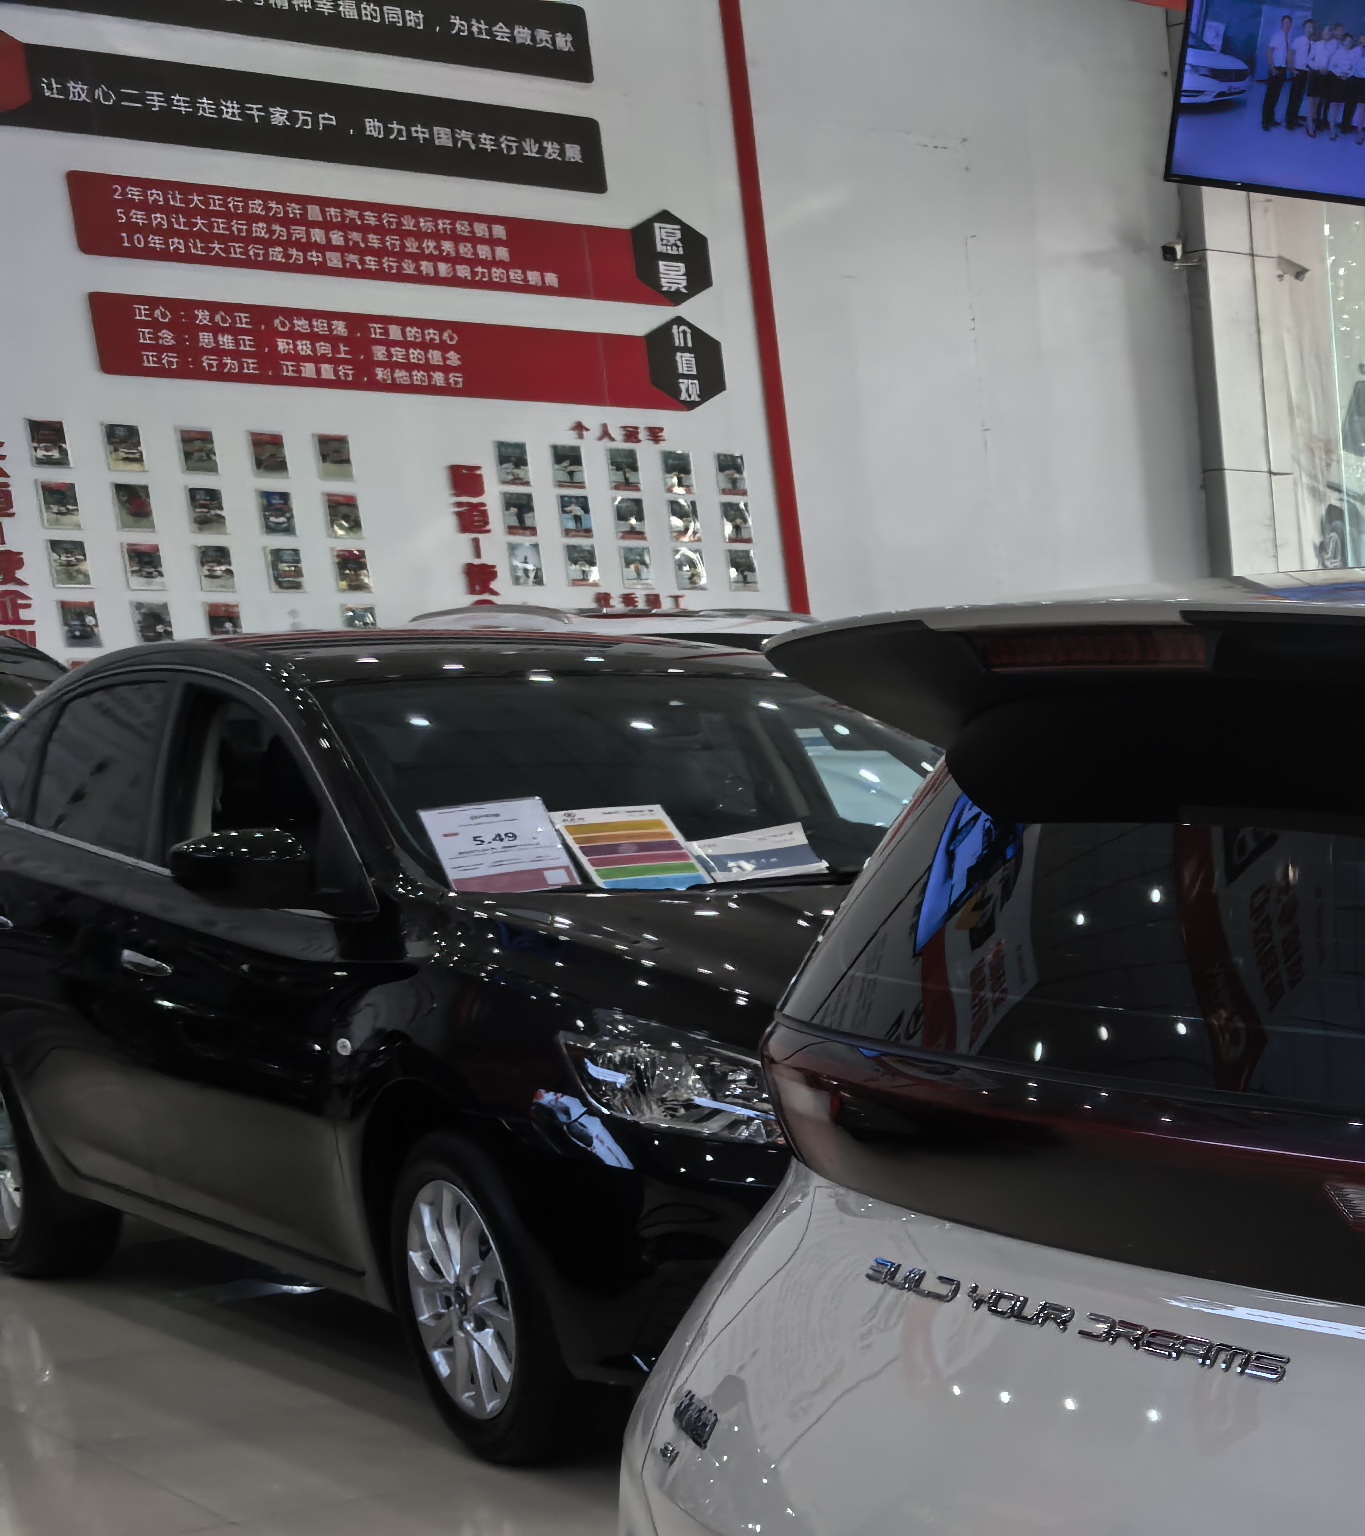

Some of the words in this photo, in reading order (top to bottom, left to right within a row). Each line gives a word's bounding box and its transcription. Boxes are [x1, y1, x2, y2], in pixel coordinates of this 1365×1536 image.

[653, 222, 688, 293] 愿景
[672, 324, 701, 402] 价值观
[472, 831, 518, 846] 5.49
[967, 1281, 1075, 1333] YOUR
[1078, 1311, 1291, 1383] DREAMS
